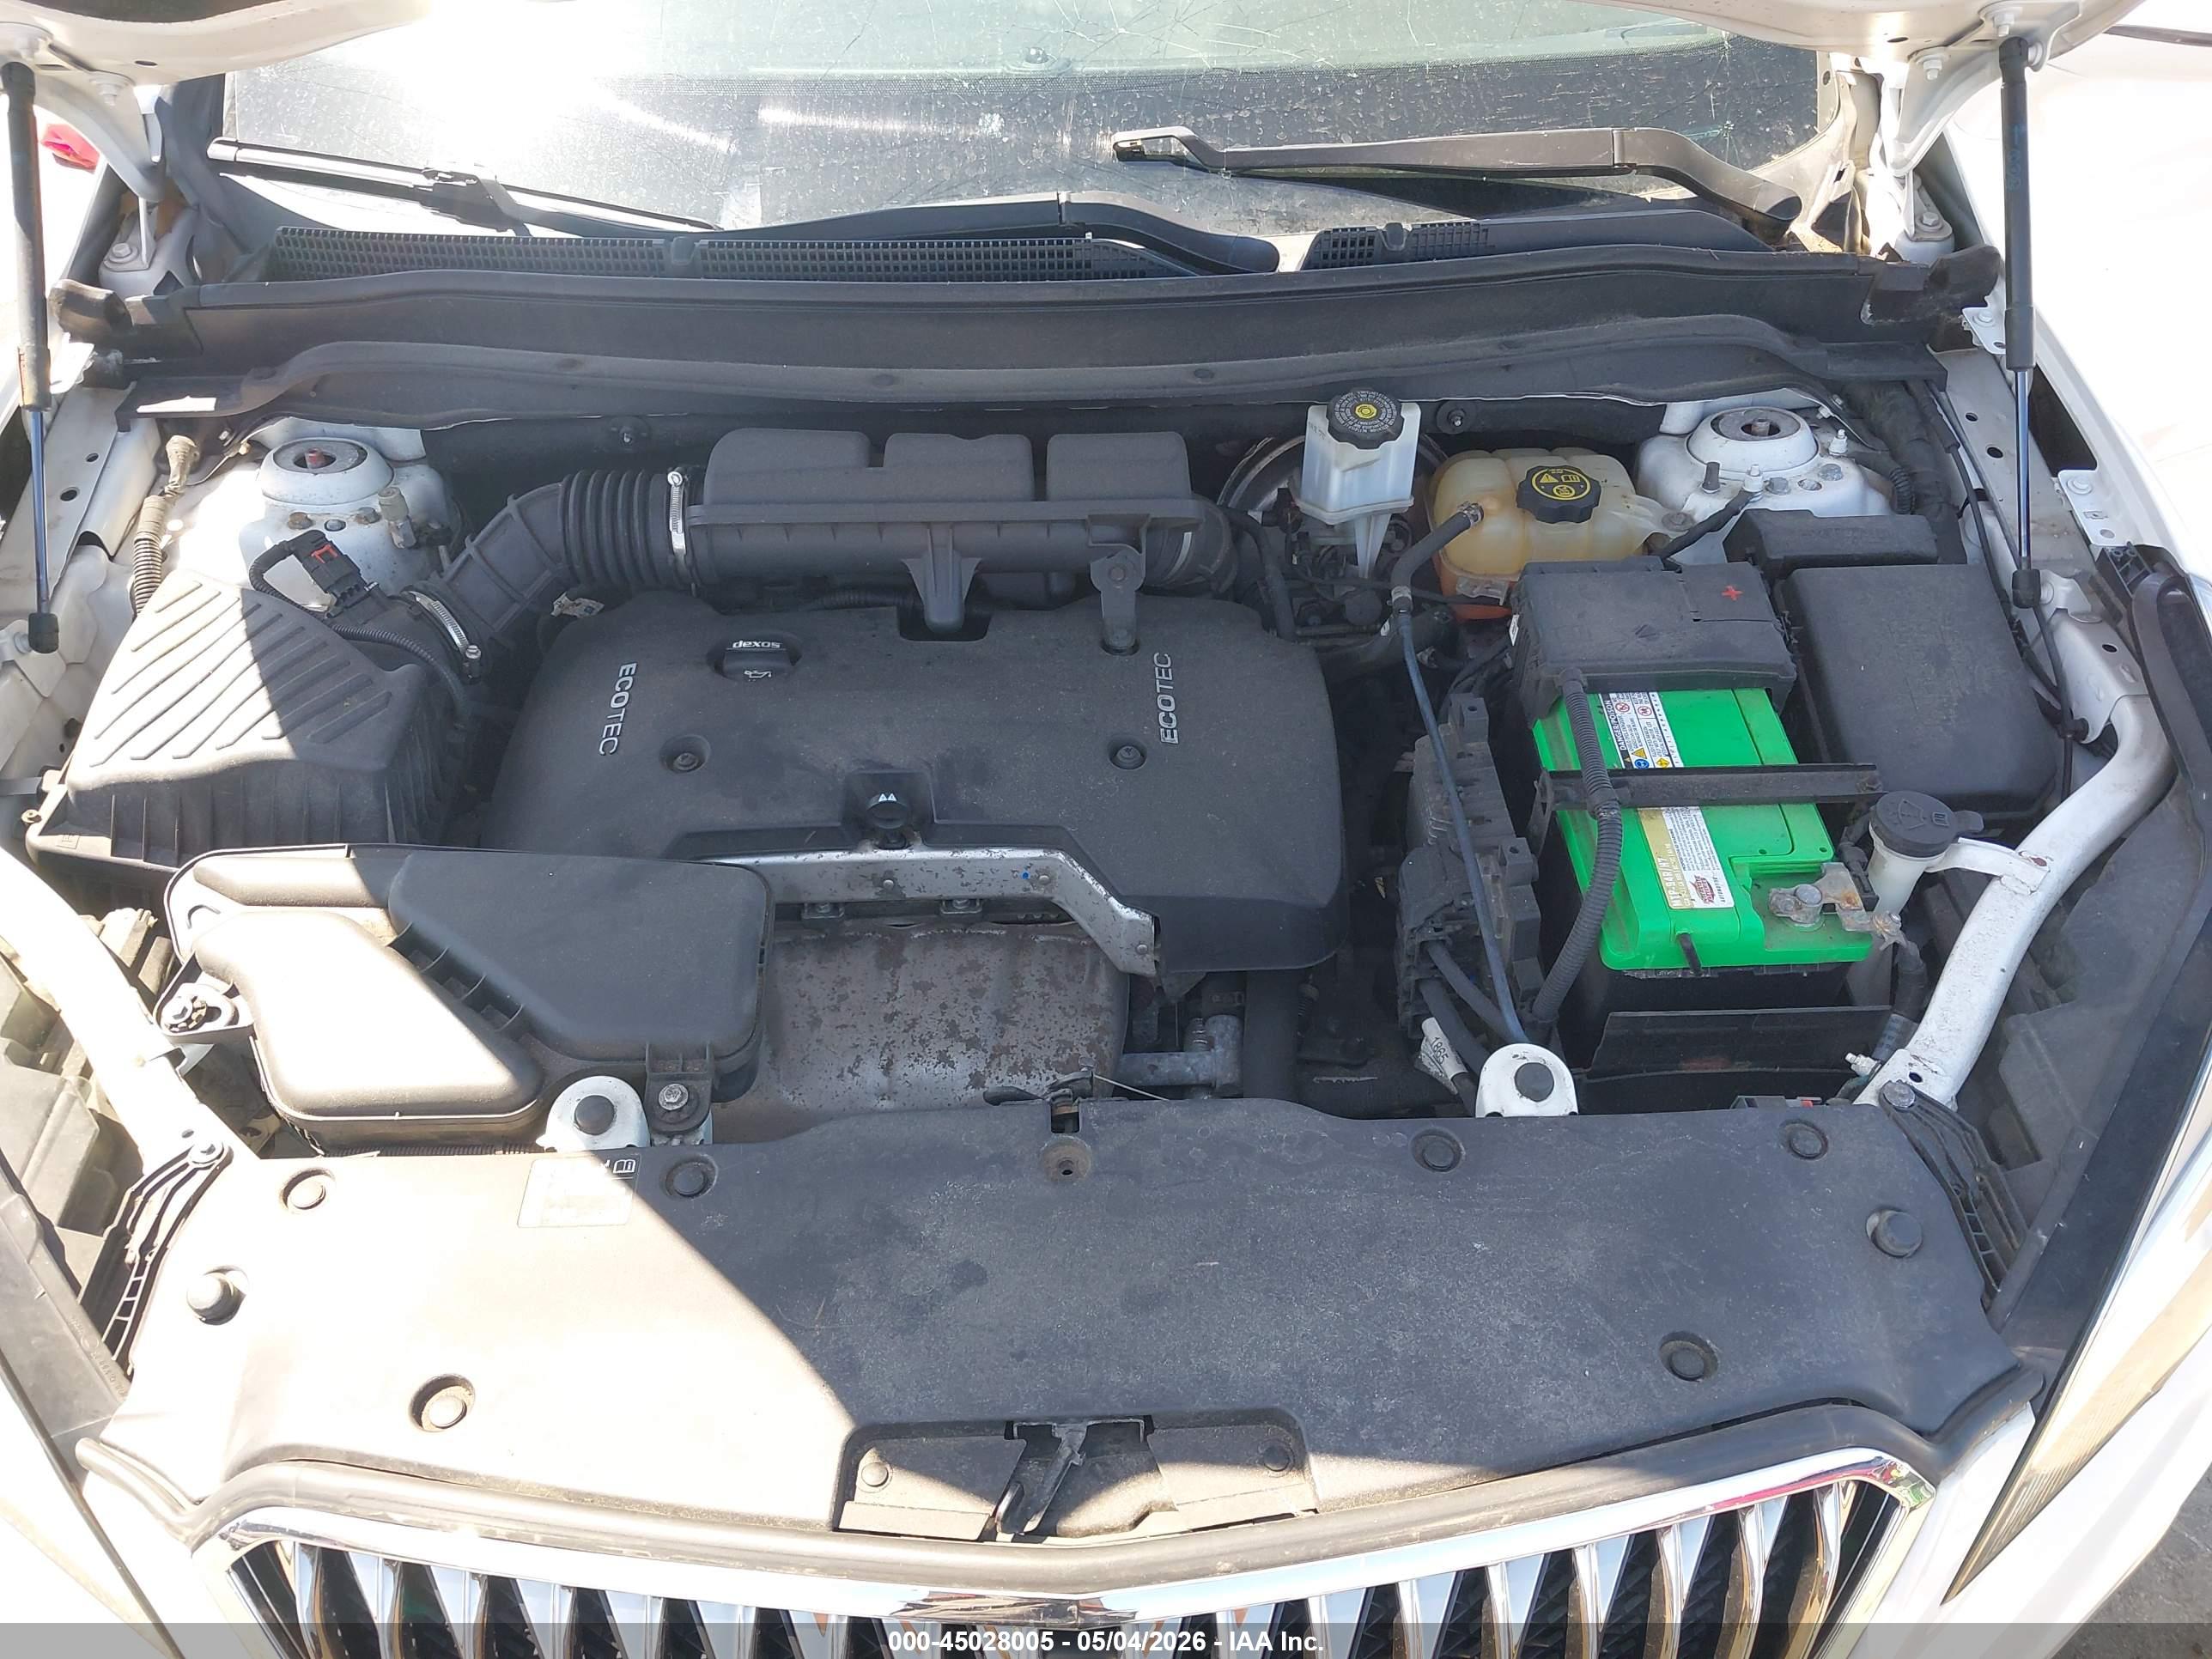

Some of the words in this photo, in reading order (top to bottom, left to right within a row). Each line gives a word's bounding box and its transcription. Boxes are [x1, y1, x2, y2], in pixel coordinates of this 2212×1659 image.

[599, 662, 637, 755] ECOTEC
[1153, 653, 1179, 744] ECOTEC
[1604, 700, 1626, 750] DANGER/POISON
[1431, 1036, 1449, 1064] 1865
